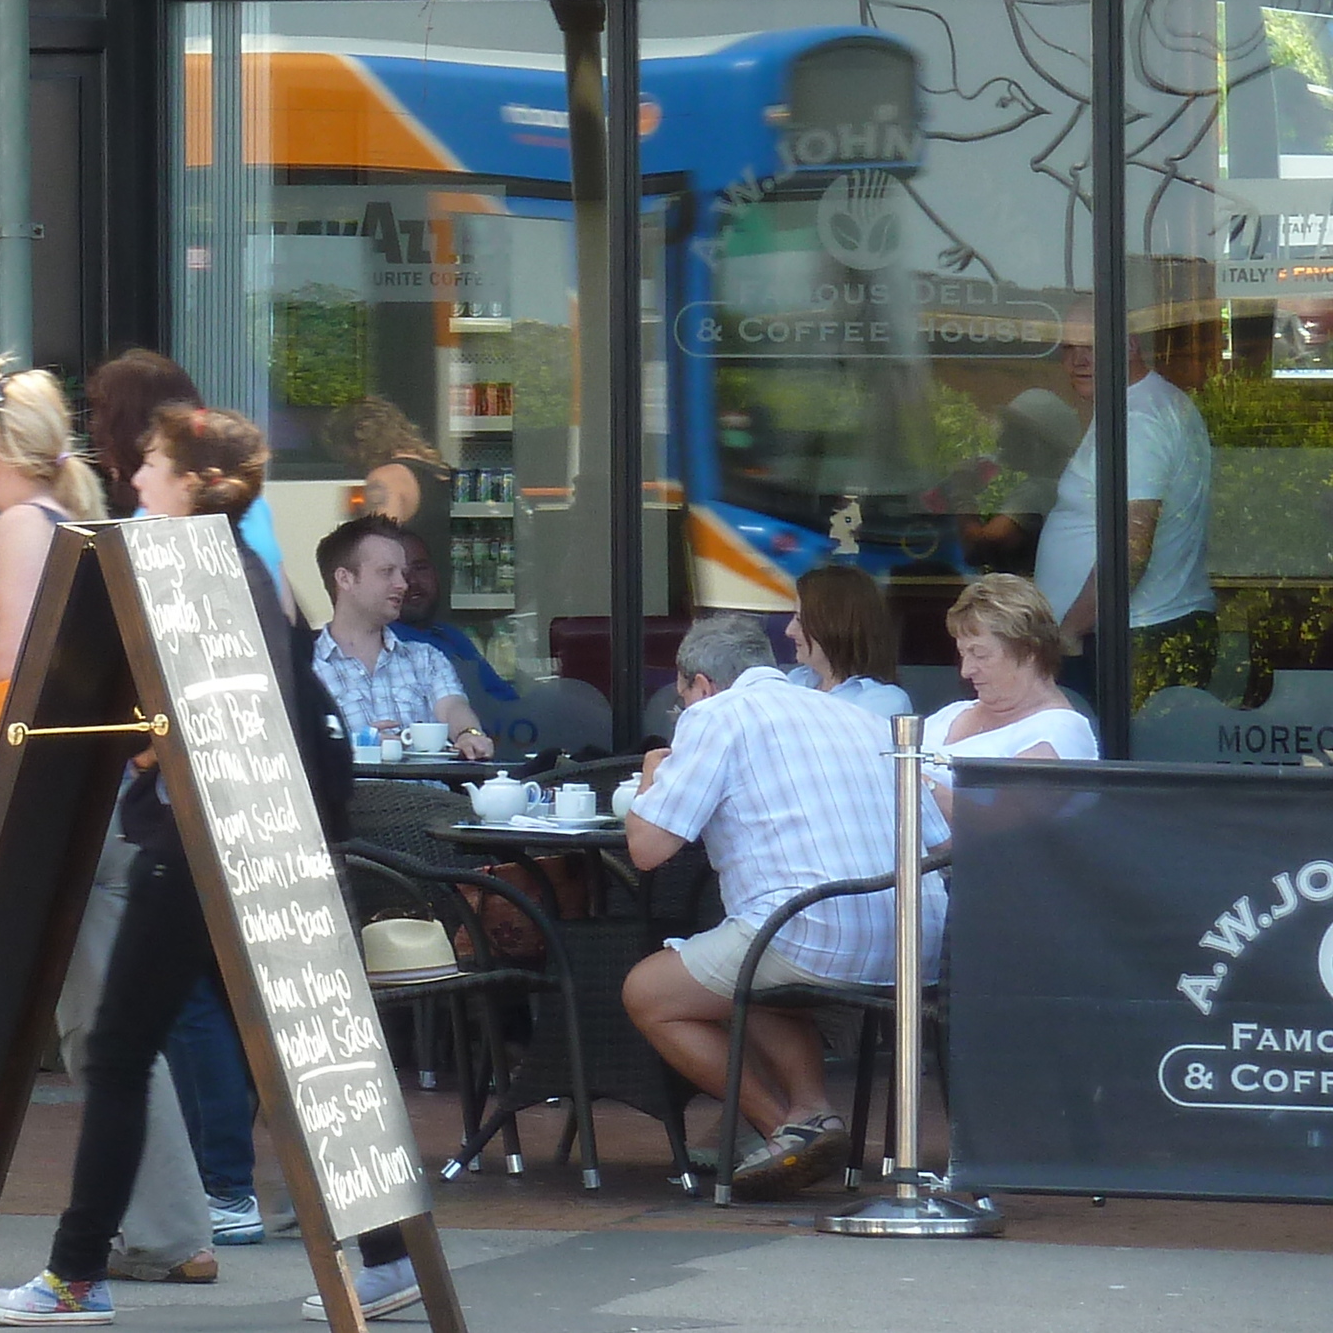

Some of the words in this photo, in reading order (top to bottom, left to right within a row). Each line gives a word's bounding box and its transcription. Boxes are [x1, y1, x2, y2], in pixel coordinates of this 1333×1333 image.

[911, 281, 1001, 306] DELI
[696, 317, 723, 343] &
[738, 317, 890, 343] COFFEE
[130, 528, 186, 588] Todays
[178, 695, 228, 747] Roast
[224, 692, 269, 745] Beef
[246, 746, 292, 785] ham
[209, 799, 255, 846] ham
[1184, 1062, 1213, 1091] &
[296, 1083, 347, 1138] Todays
[319, 1136, 377, 1211] French
